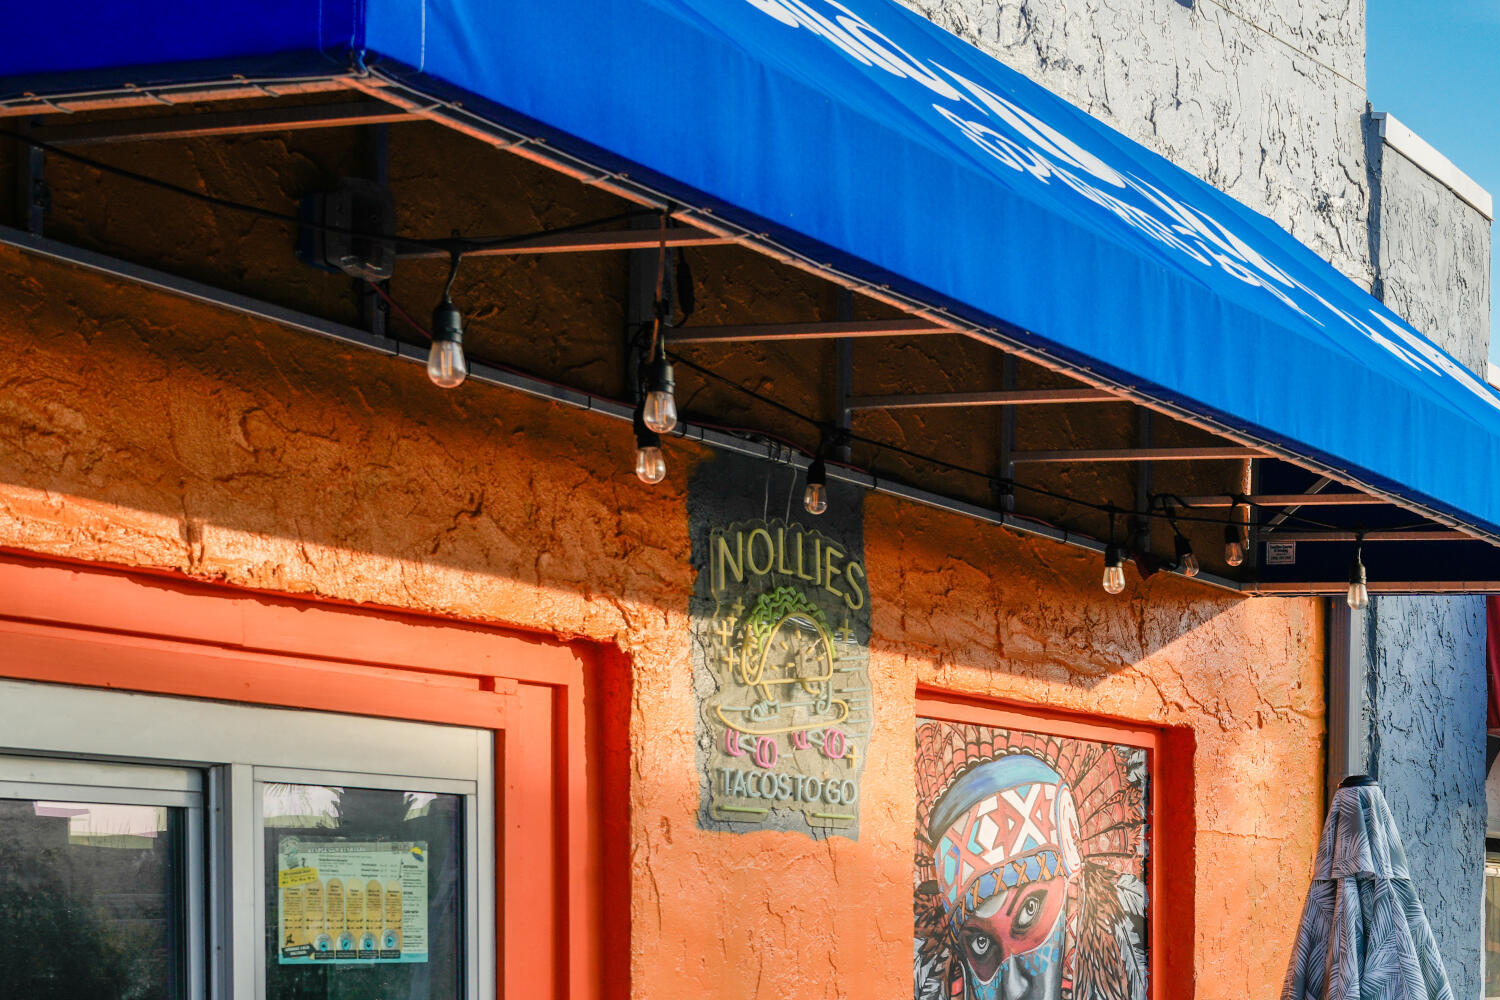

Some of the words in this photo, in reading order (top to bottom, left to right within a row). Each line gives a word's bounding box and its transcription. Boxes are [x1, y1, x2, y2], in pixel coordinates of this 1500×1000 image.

[931, 103, 1213, 267] SPORTS
[718, 527, 865, 610] NOLLIES
[722, 767, 791, 801] TACOS
[793, 773, 822, 803] TO
[824, 777, 858, 805] GO
